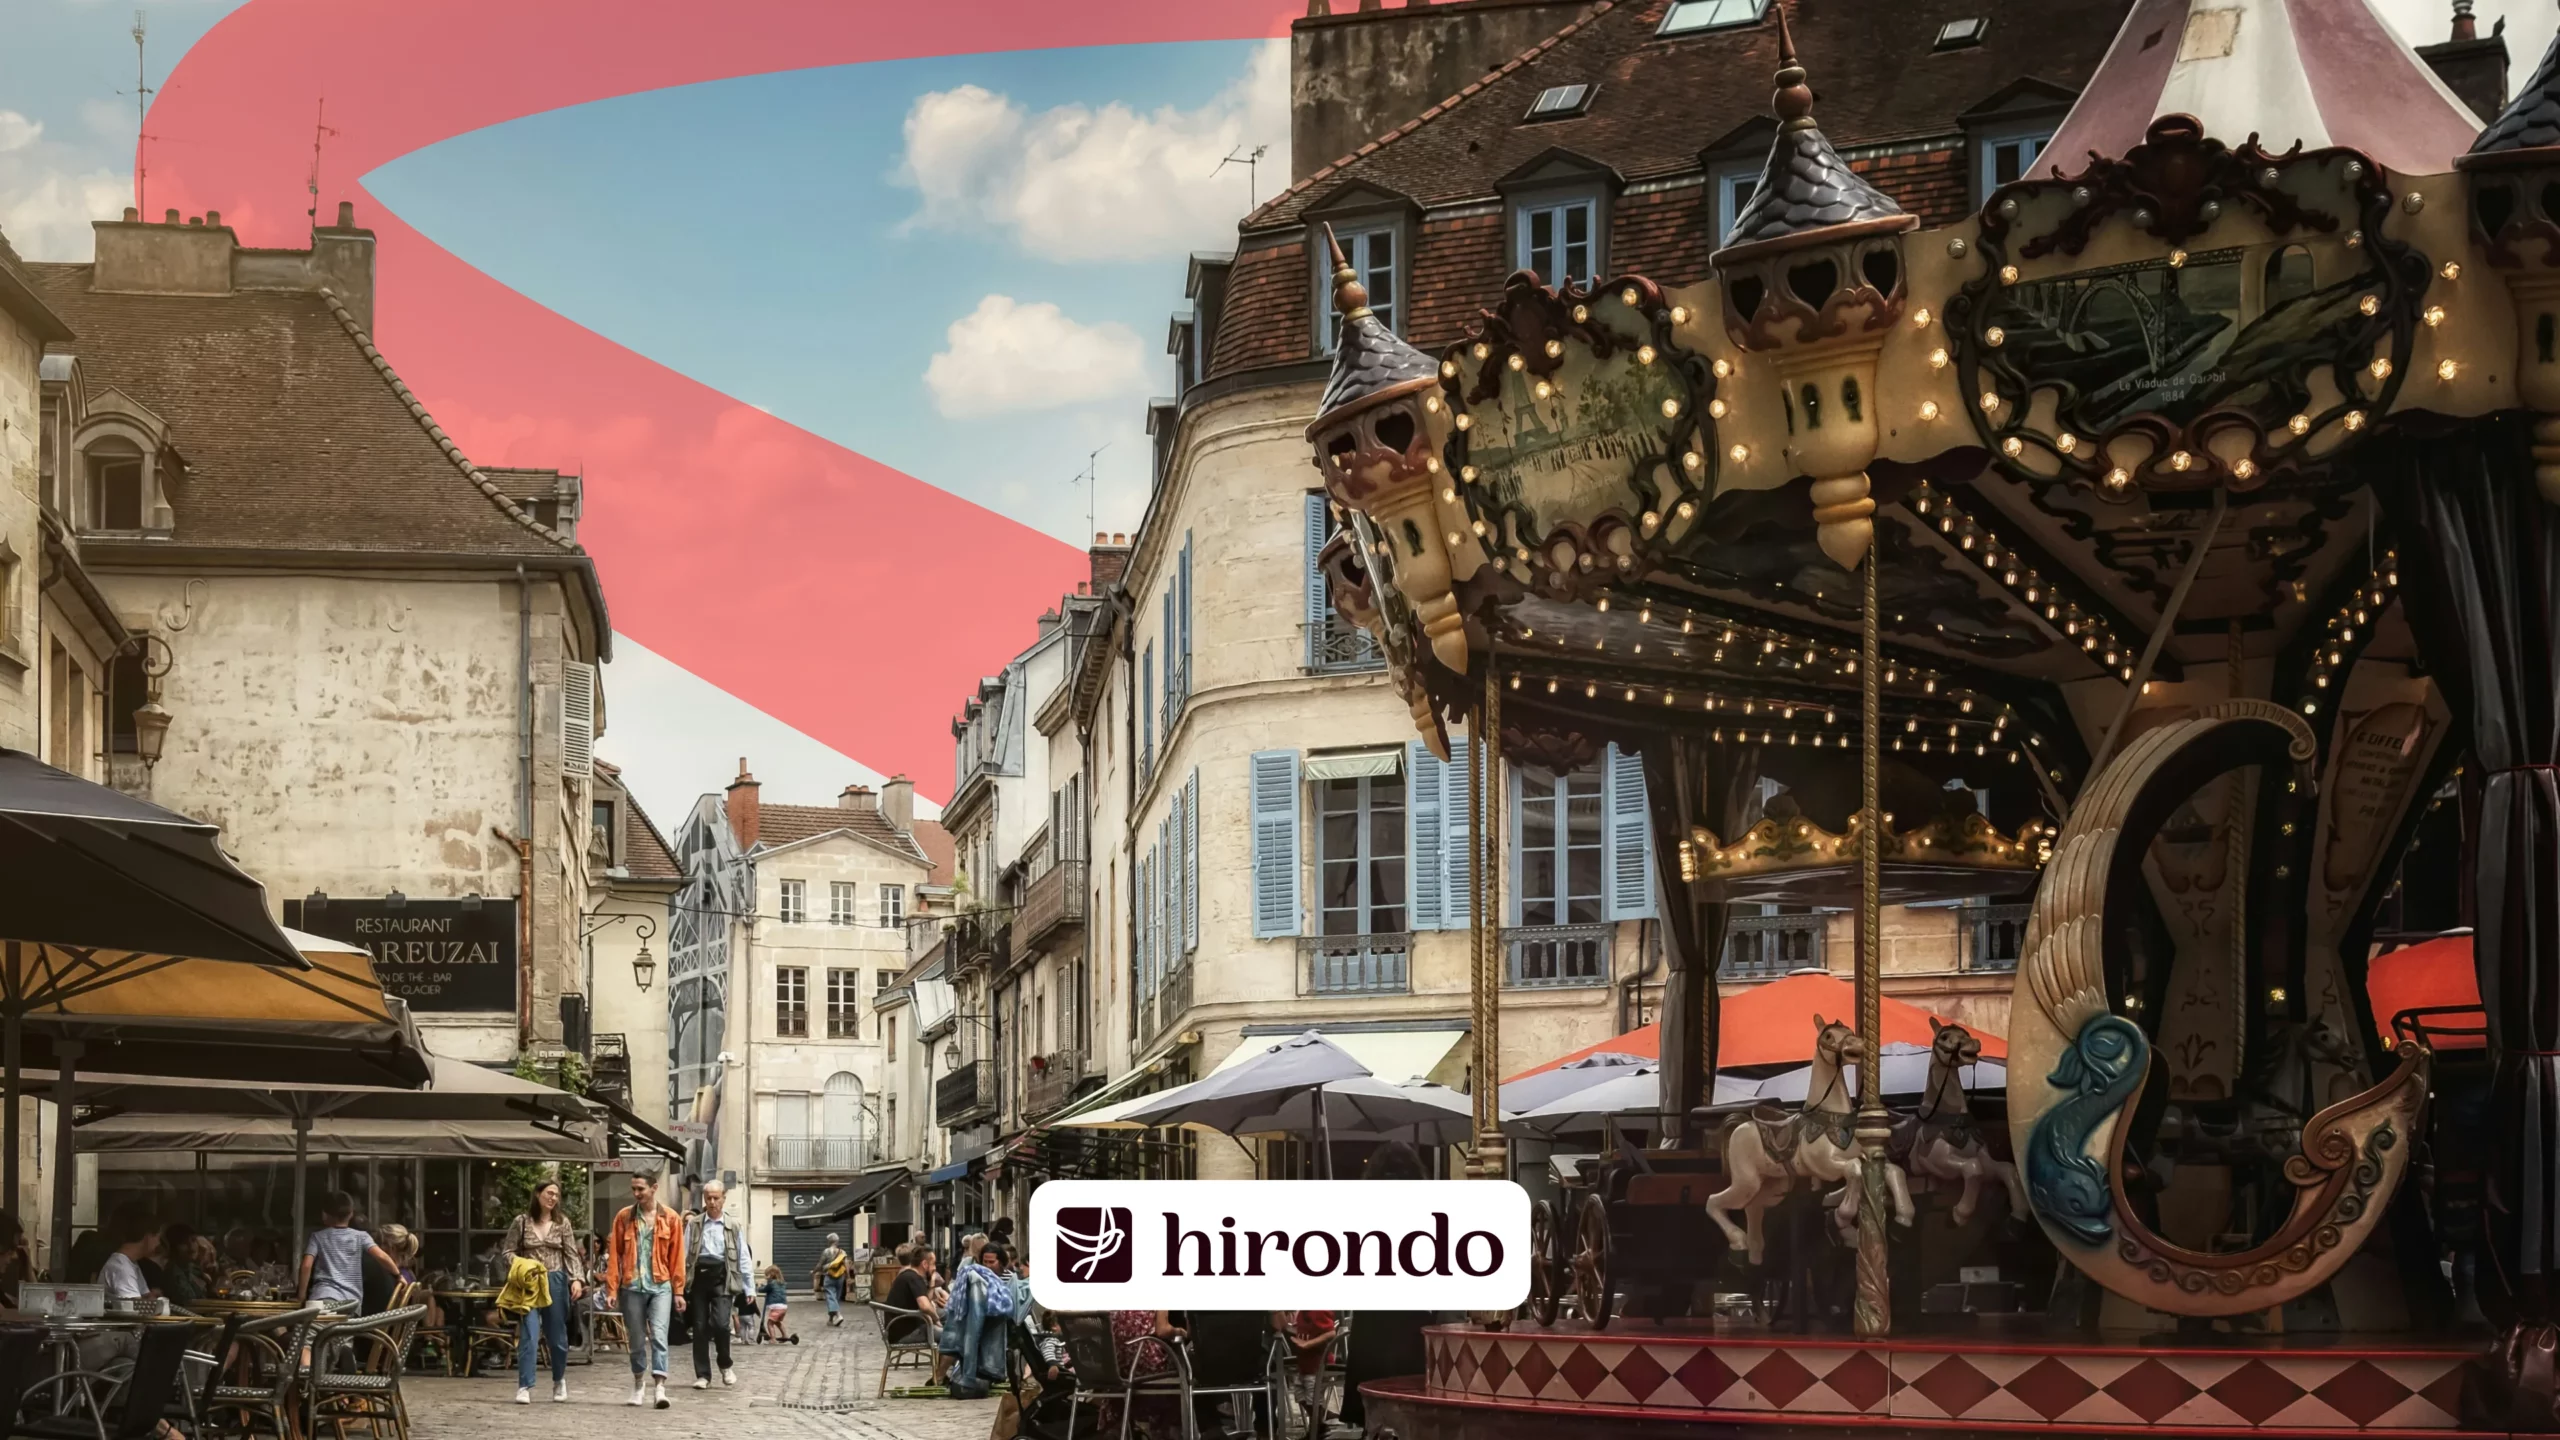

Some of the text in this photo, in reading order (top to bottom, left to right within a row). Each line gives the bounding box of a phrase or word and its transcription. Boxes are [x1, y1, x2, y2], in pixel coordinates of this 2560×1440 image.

[2118, 381, 2131, 391] Le
[2135, 376, 2169, 389] Viaduc
[2172, 376, 2186, 386] de
[2161, 389, 2186, 402] 1884
[355, 917, 453, 933] RESTAURANT
[346, 941, 500, 964] AREUZAI
[392, 972, 405, 982] DE
[433, 972, 452, 982] BAR
[401, 984, 442, 995] GLACIER
